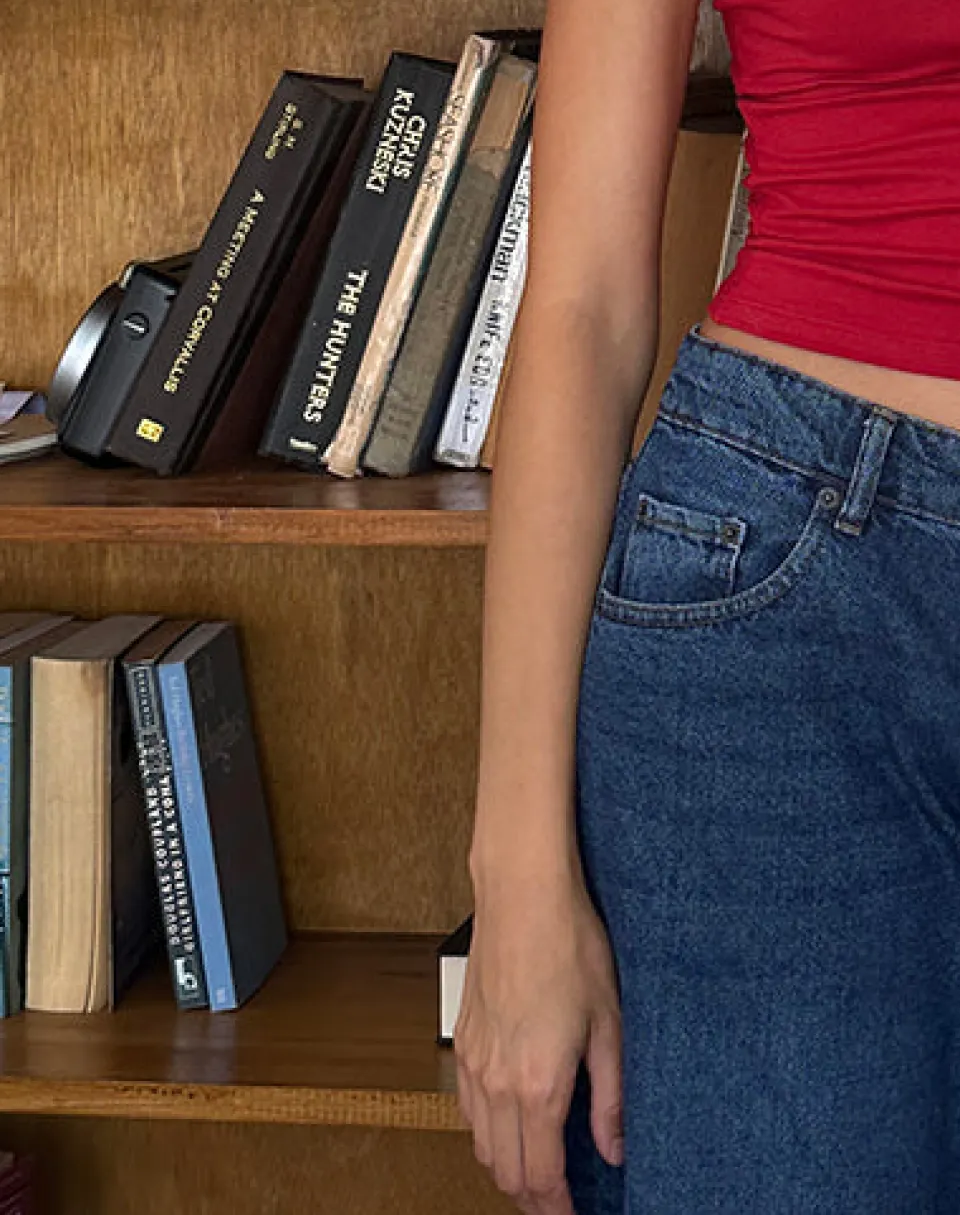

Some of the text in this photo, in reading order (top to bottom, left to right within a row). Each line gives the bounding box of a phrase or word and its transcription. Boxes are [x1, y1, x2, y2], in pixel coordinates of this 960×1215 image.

[365, 87, 415, 194] KUZNESKI
[392, 115, 427, 179] CHRIS
[164, 189, 265, 393] A MEETING AT CORVALLIS
[303, 269, 370, 423] THE HUNTERS
